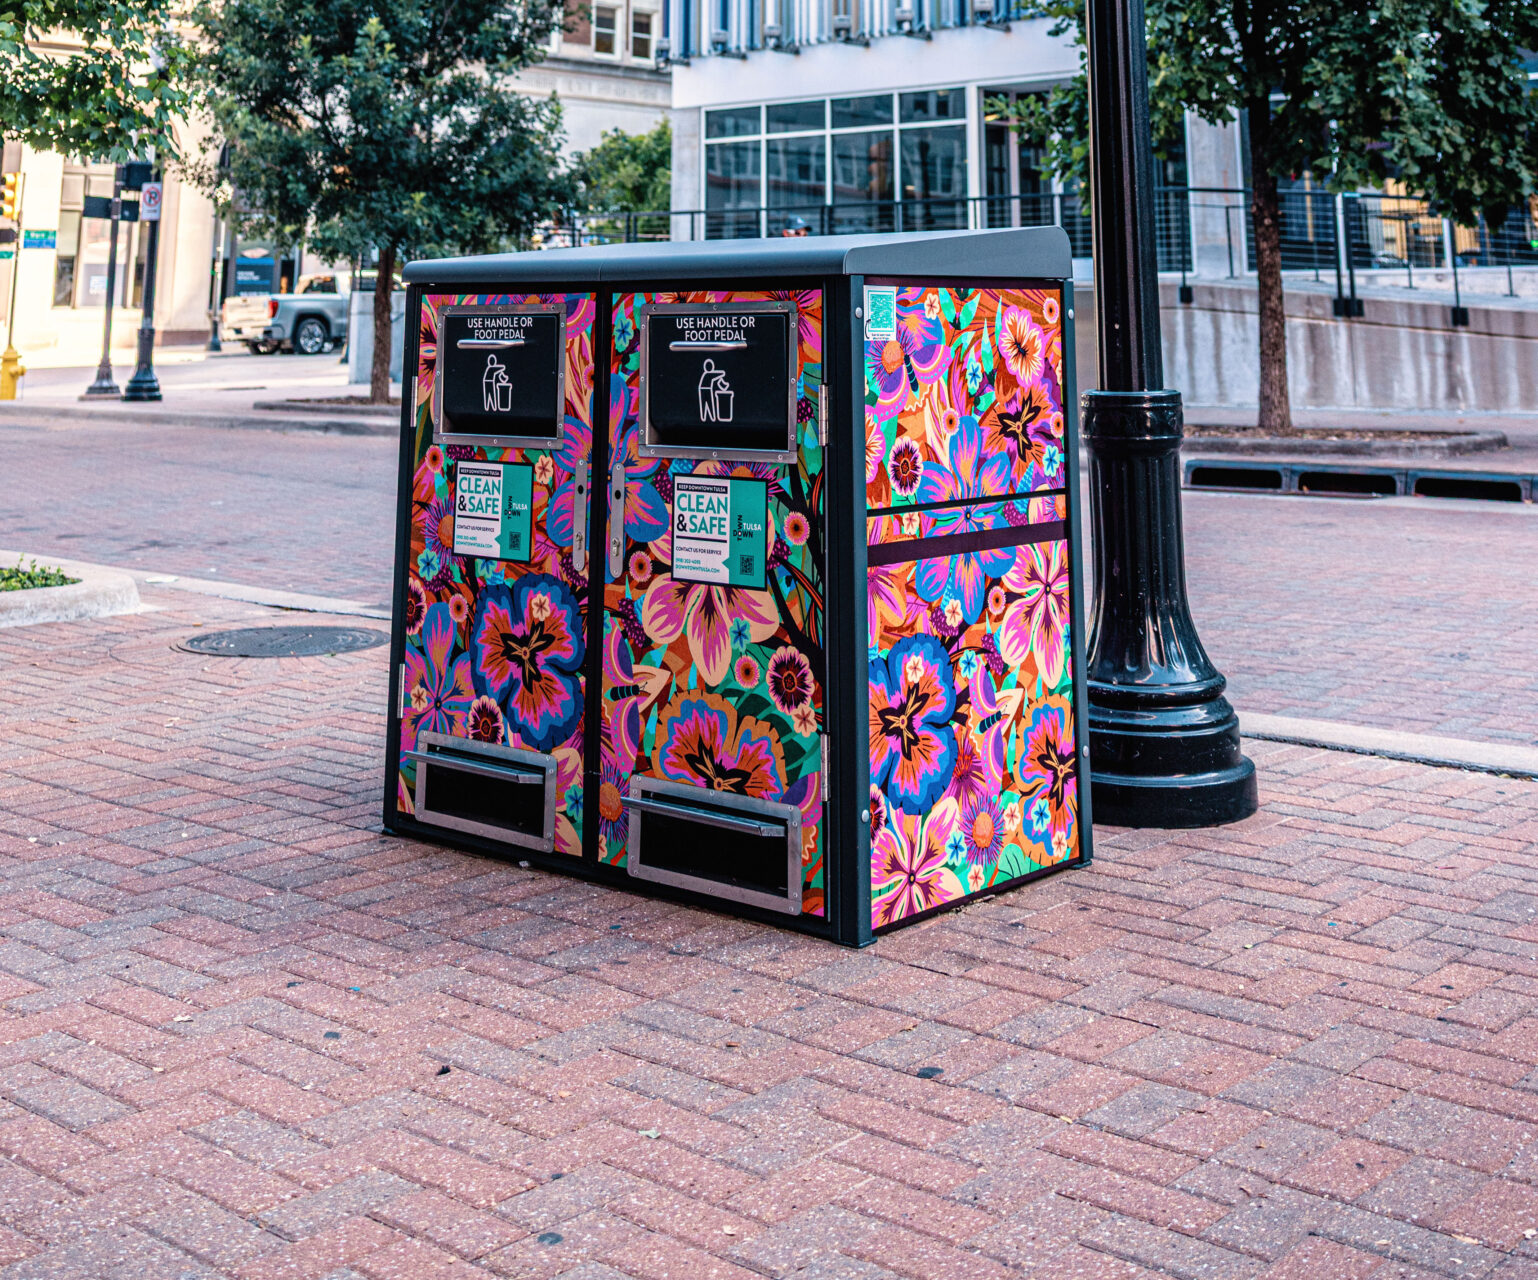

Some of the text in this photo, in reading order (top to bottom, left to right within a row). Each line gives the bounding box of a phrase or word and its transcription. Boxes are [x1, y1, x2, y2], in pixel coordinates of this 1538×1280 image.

[467, 317, 533, 328] USE HANDLE OR
[676, 316, 756, 329] USE HANDLE OR
[474, 329, 526, 340] FOOT PEDAL
[685, 330, 747, 341] FOOT PEDAL
[459, 477, 502, 495] CLEAN
[512, 502, 528, 510] TULSA
[676, 493, 728, 515] CLEAN
[743, 522, 762, 531] TULSA
